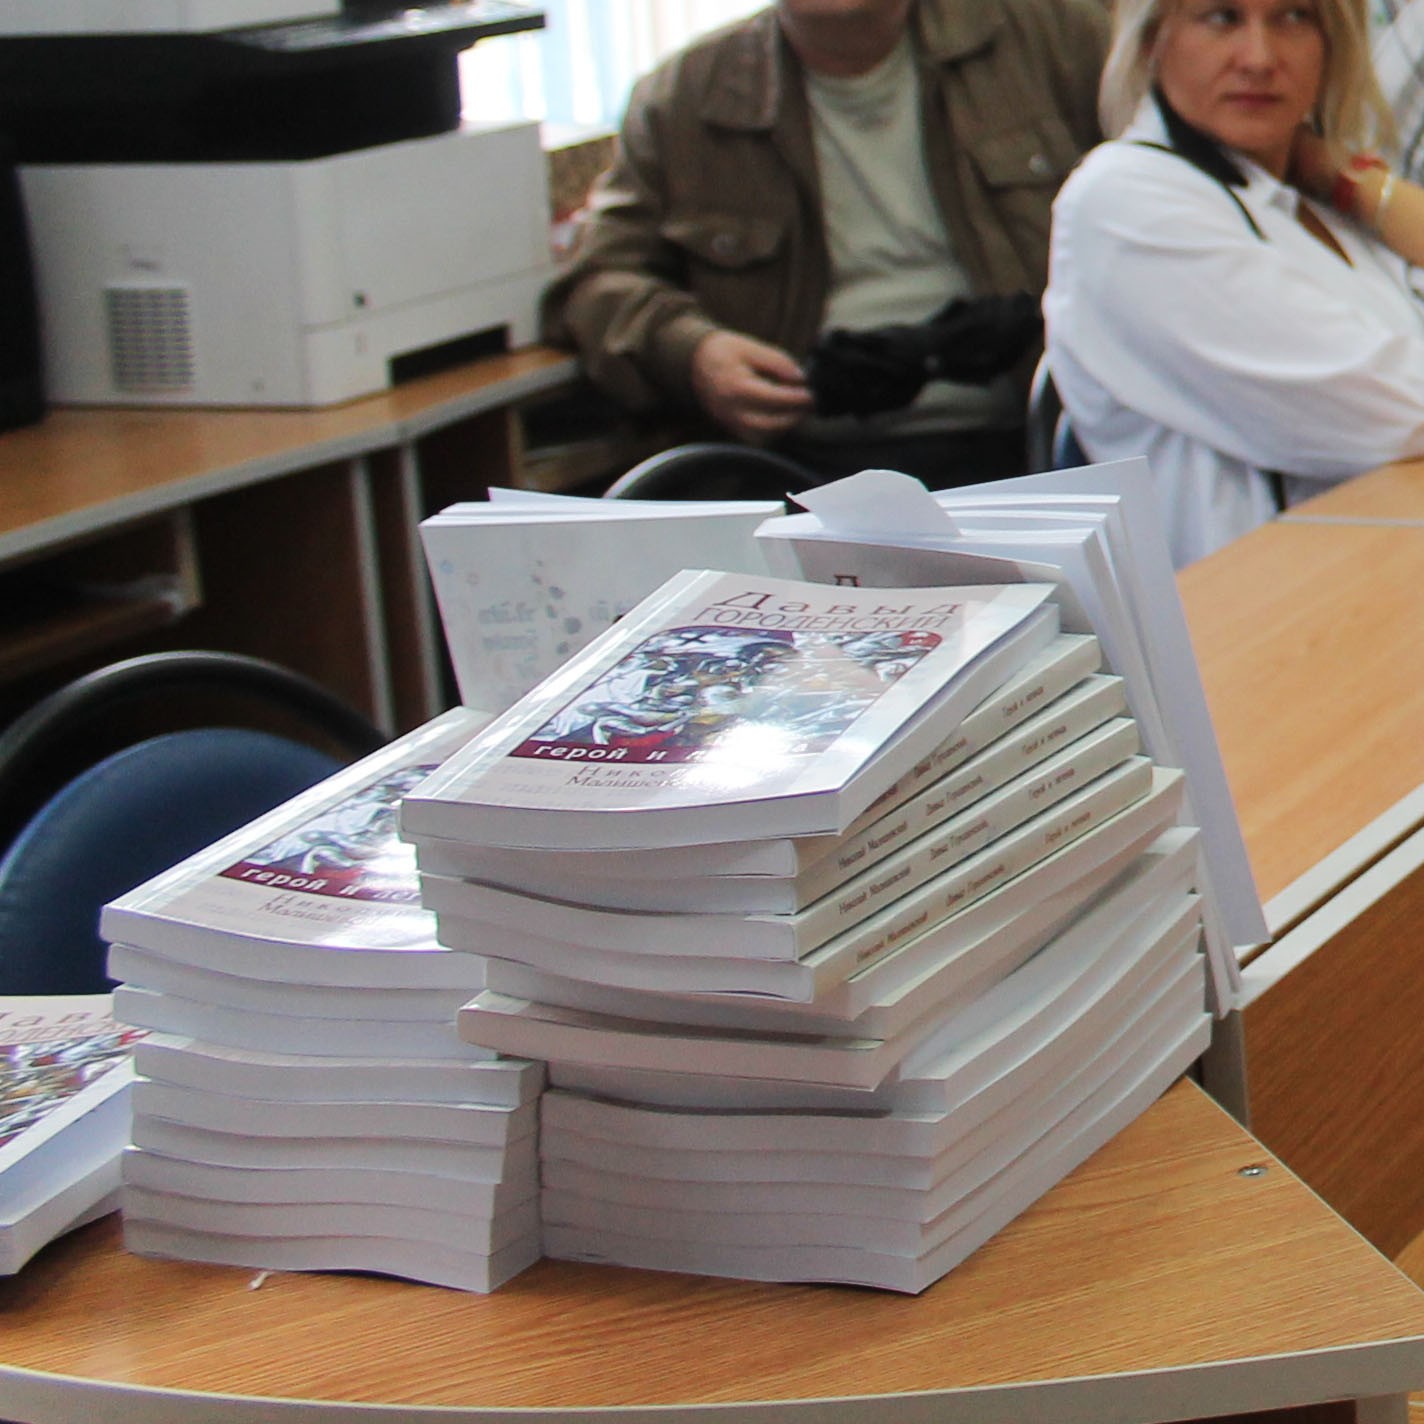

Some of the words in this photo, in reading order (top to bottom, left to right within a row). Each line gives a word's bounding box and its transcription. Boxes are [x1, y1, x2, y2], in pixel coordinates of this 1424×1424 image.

[712, 591, 963, 615] Давыд
[694, 606, 953, 628] ГОРОДЕНСКИЙ
[532, 743, 629, 761] герой
[645, 750, 668, 761] и
[240, 867, 328, 891] герой
[339, 883, 362, 896] и
